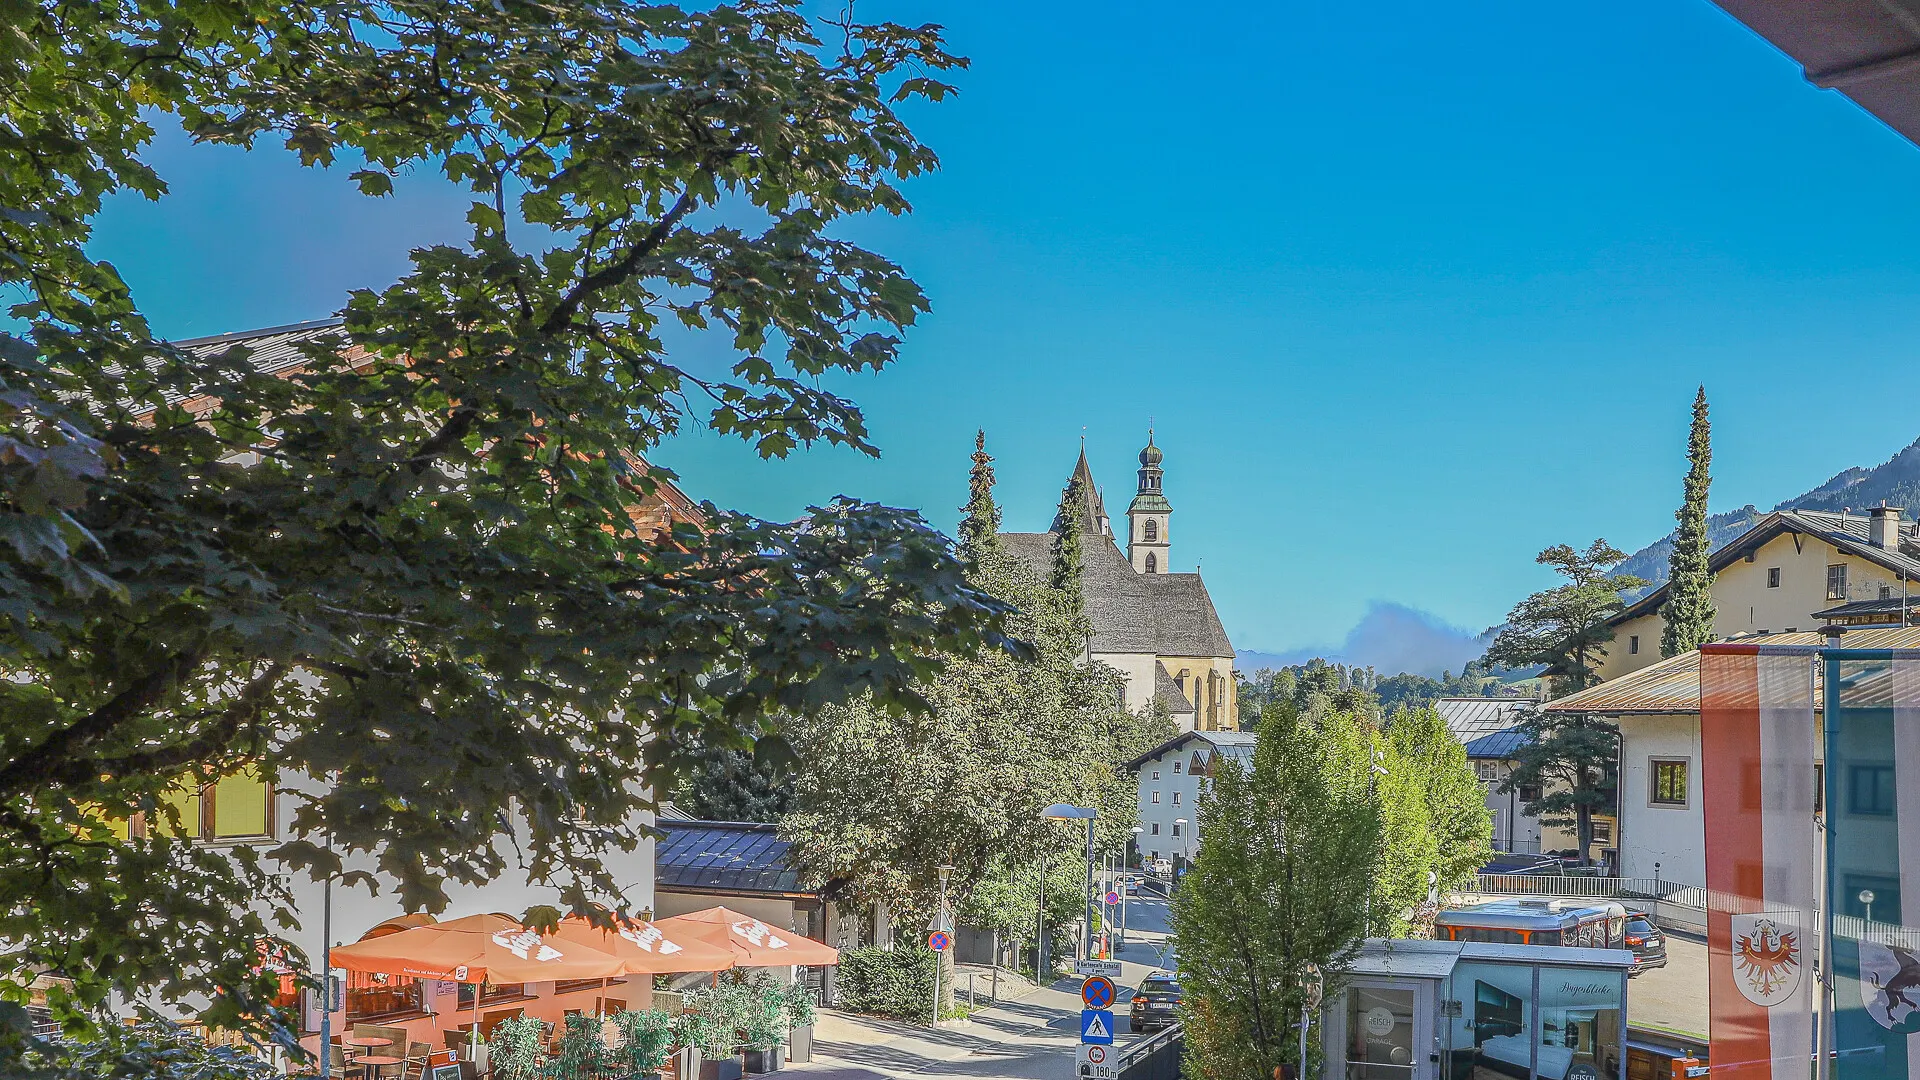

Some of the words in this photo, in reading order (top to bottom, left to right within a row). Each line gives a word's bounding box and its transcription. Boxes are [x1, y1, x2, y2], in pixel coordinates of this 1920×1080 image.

[1368, 1017, 1391, 1026] REISCH
[1095, 1066, 1110, 1078] 180
[1111, 1071, 1117, 1079] m
